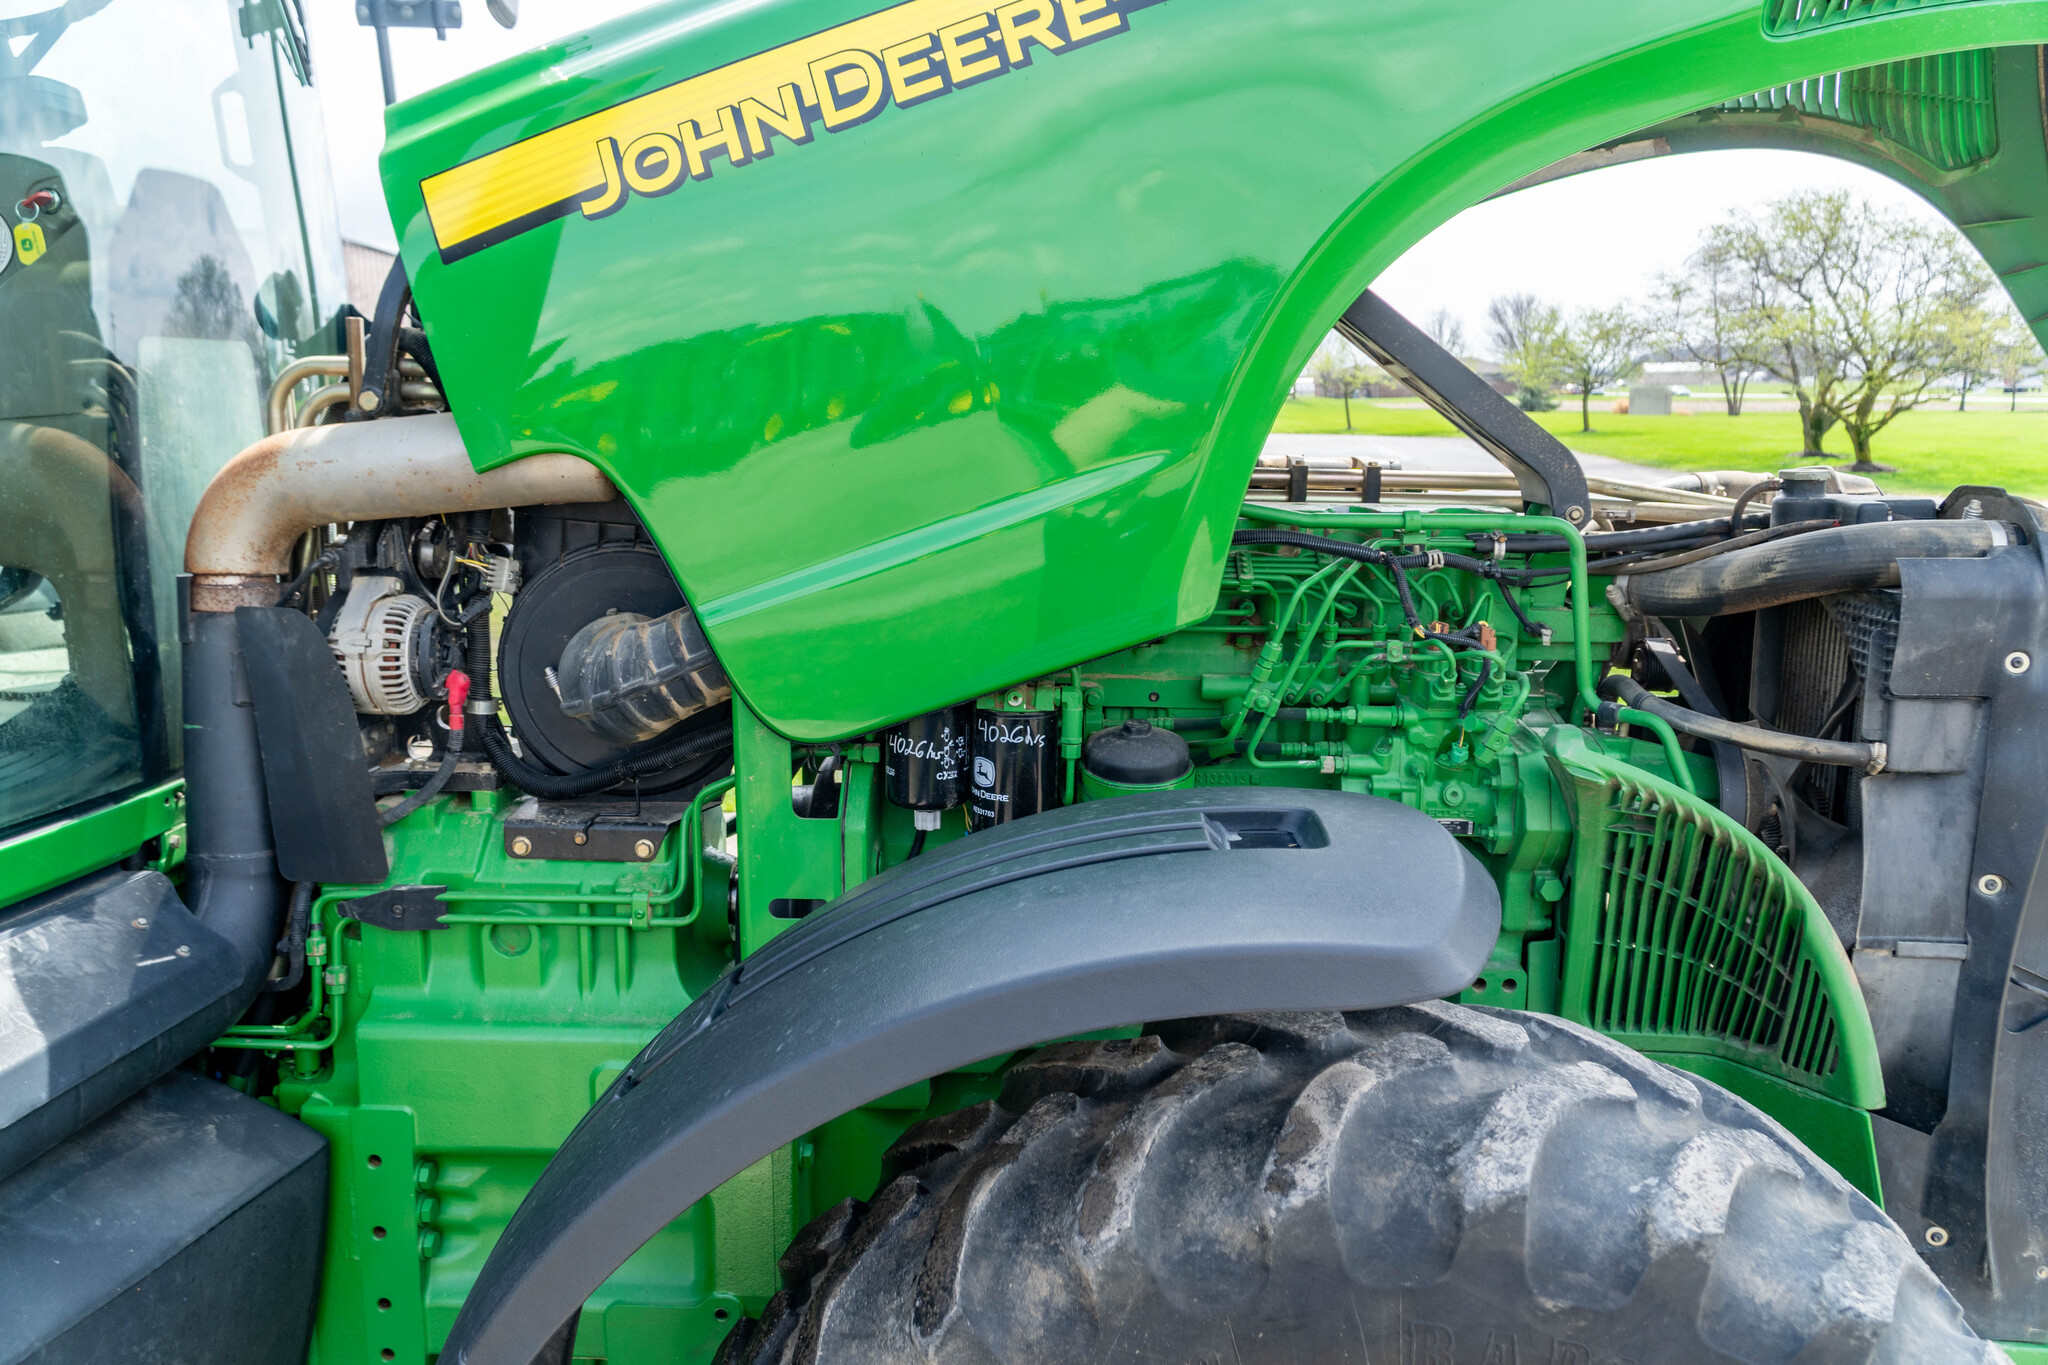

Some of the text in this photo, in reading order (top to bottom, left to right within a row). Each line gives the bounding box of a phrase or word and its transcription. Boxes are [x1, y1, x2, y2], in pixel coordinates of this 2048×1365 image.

[581, 0, 1130, 220] JOHN DEERE
[980, 790, 1010, 802] DEERE
